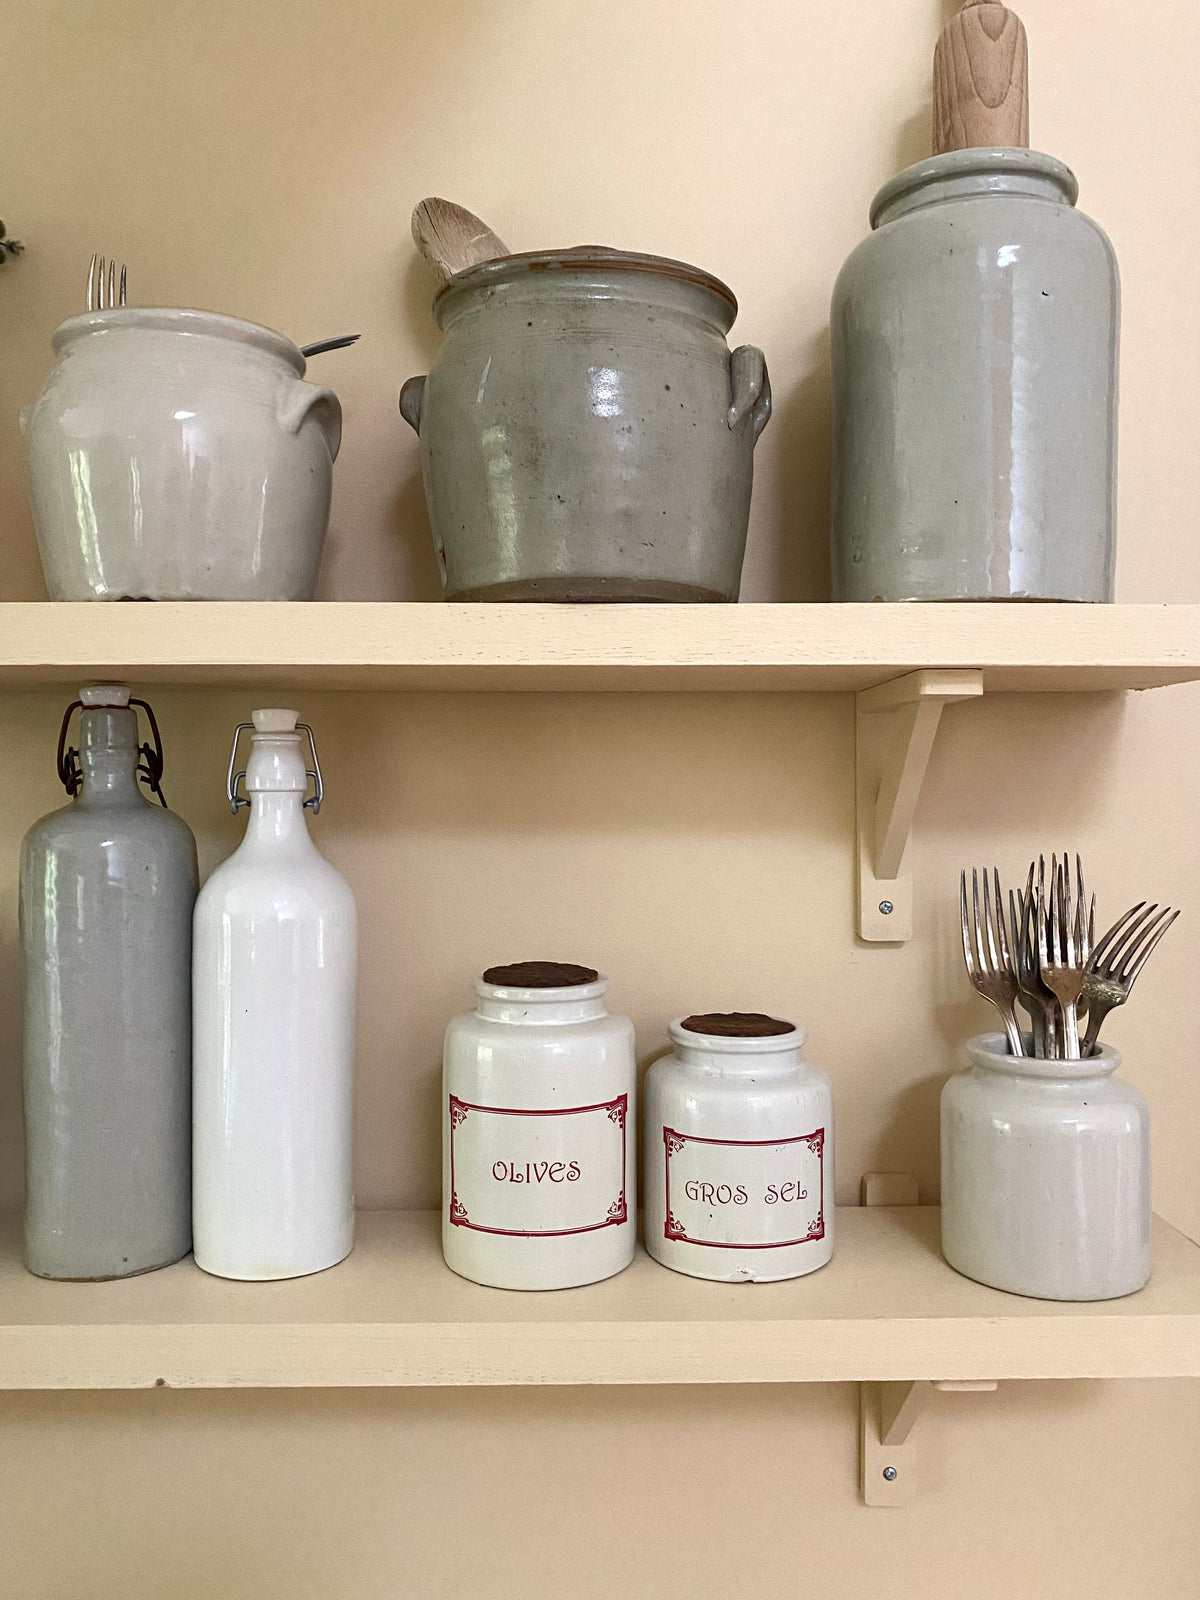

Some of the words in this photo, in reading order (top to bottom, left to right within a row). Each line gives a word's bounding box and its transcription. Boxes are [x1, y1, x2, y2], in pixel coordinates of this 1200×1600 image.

[492, 1160, 581, 1184] OLIVES
[684, 1180, 748, 1206] GROS
[764, 1180, 808, 1205] SEL
